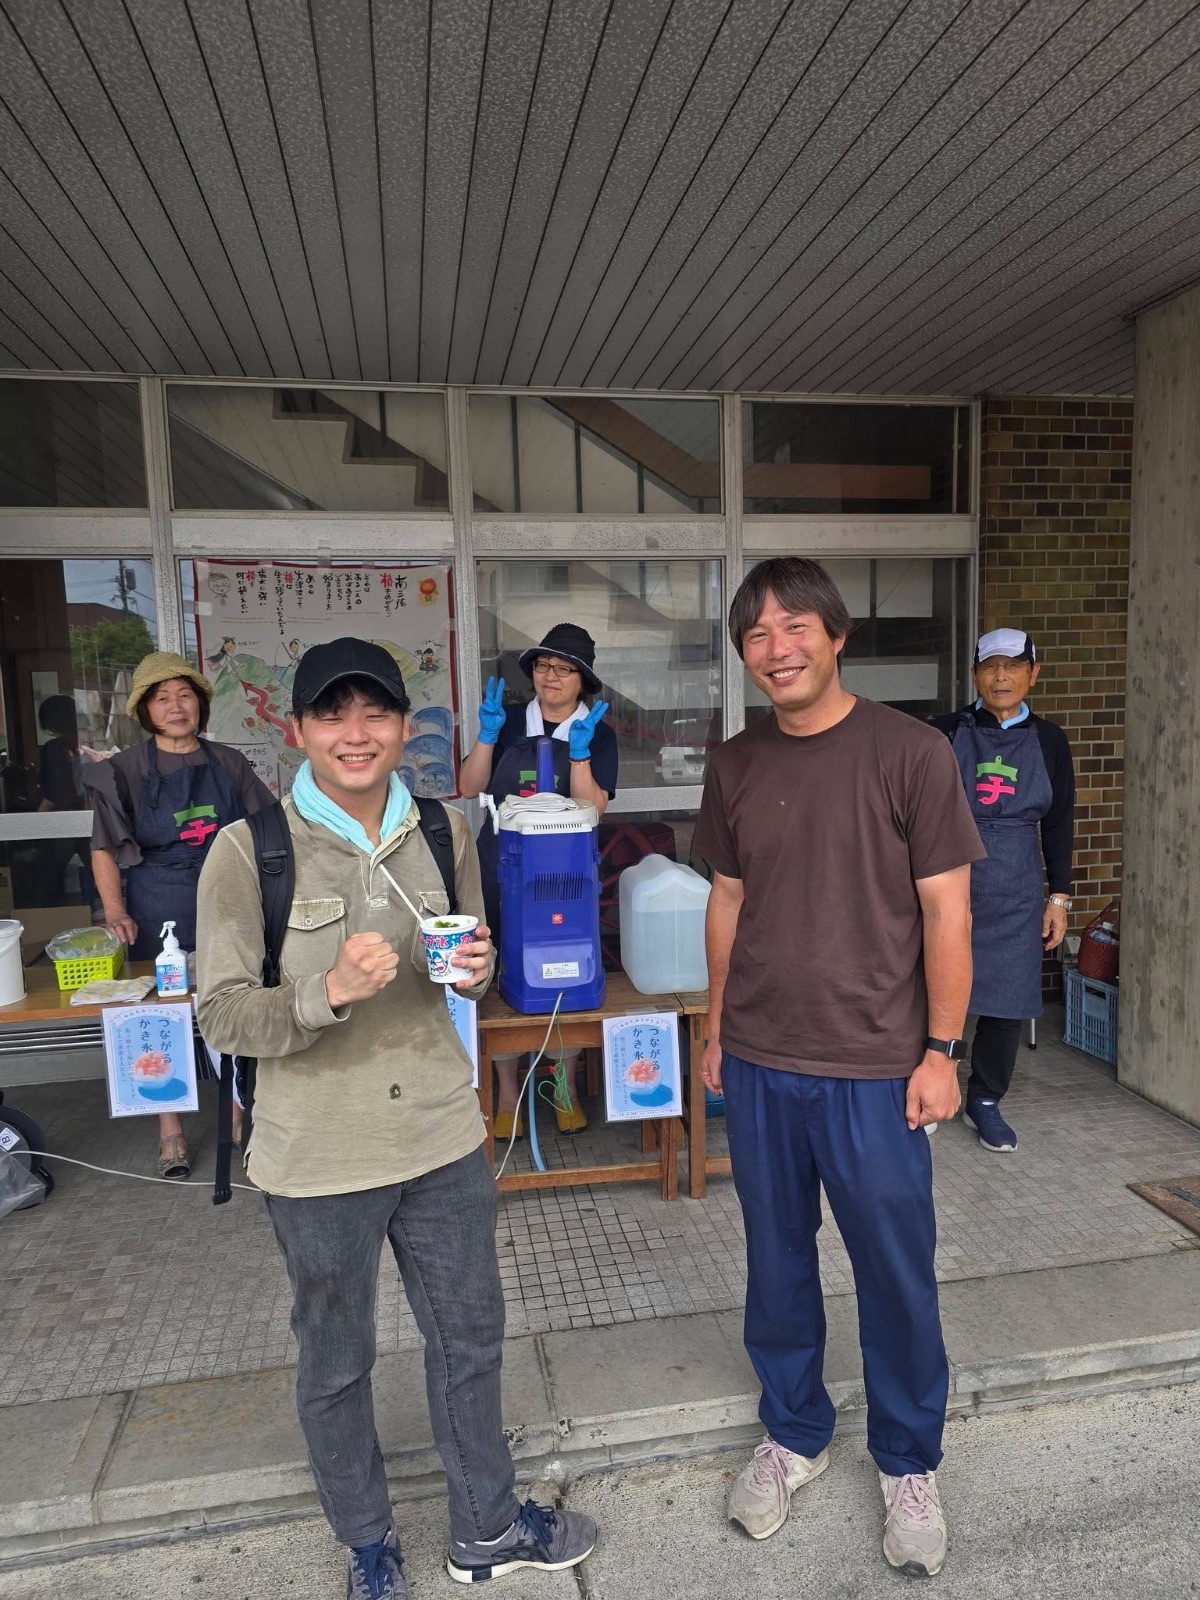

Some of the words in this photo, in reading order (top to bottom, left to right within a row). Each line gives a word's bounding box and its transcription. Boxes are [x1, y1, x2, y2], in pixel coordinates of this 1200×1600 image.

[394, 574, 408, 610] 南三陸
[139, 1018, 153, 1053] かき氷
[158, 1018, 172, 1064] つながる
[632, 1027, 644, 1061] かき氷
[649, 1028, 660, 1071] つながる
